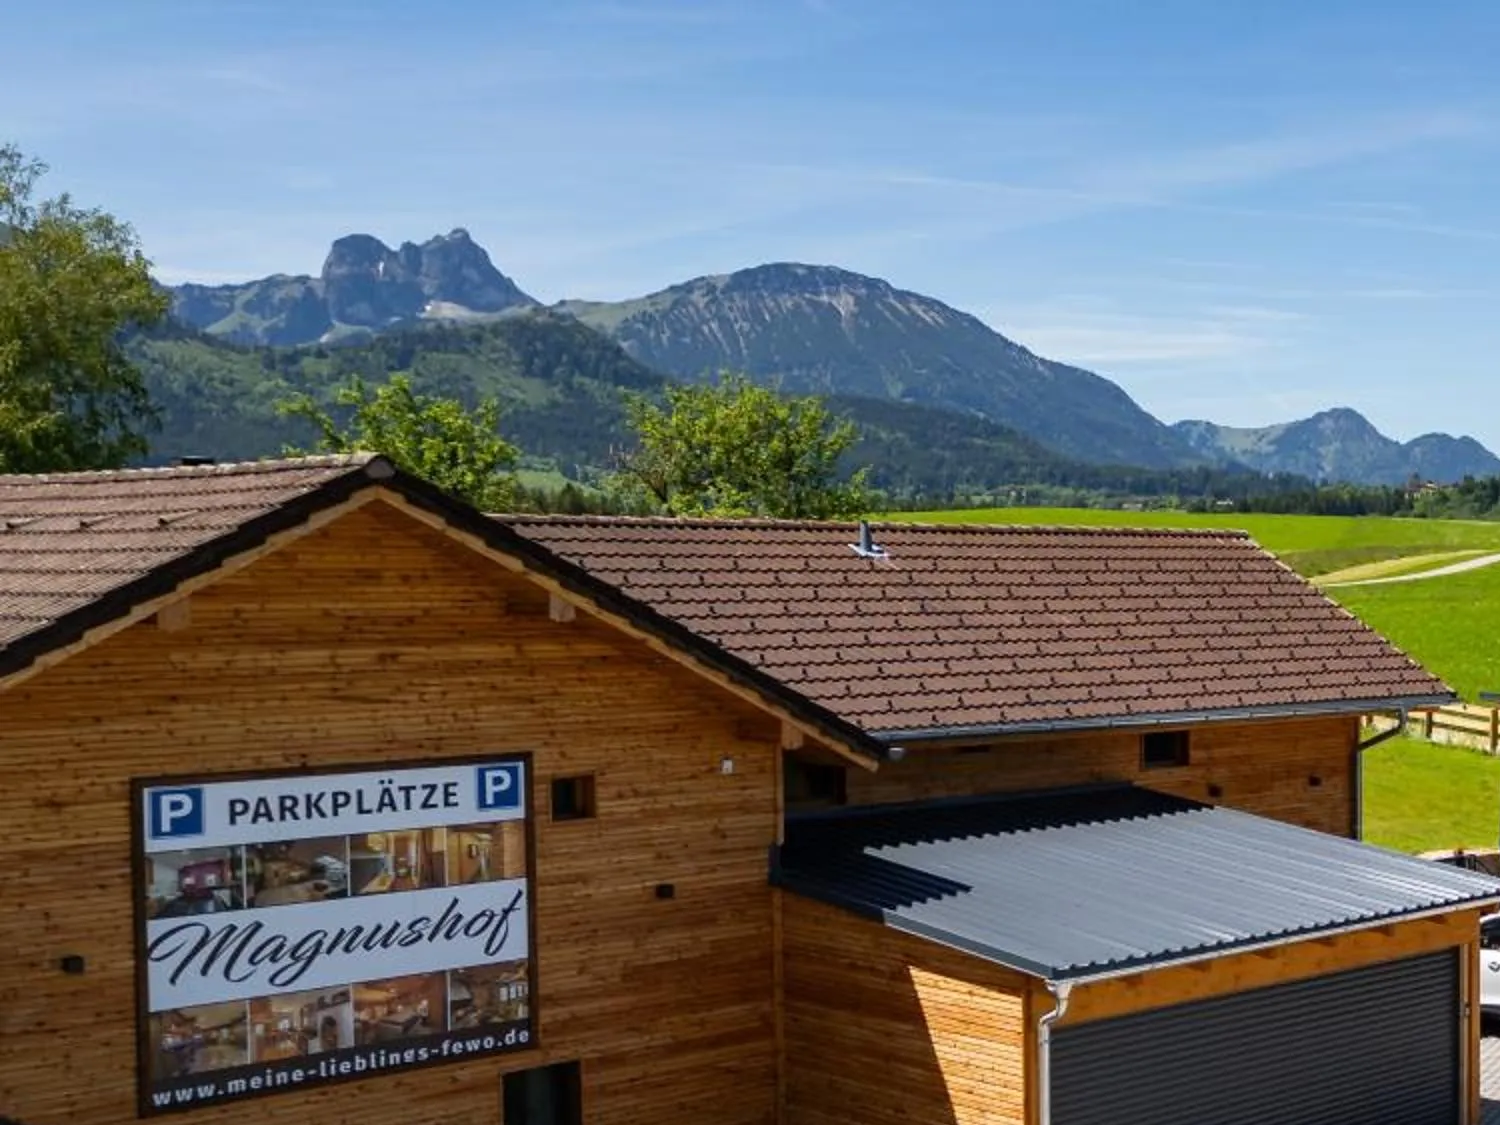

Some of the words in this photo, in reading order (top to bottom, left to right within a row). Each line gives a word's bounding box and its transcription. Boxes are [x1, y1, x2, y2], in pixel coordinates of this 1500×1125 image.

[228, 779, 460, 826] PARKPLÄTZE
[147, 889, 523, 987] Magnushof
[152, 1028, 530, 1108] www.meine-lieblings-fewo.de
